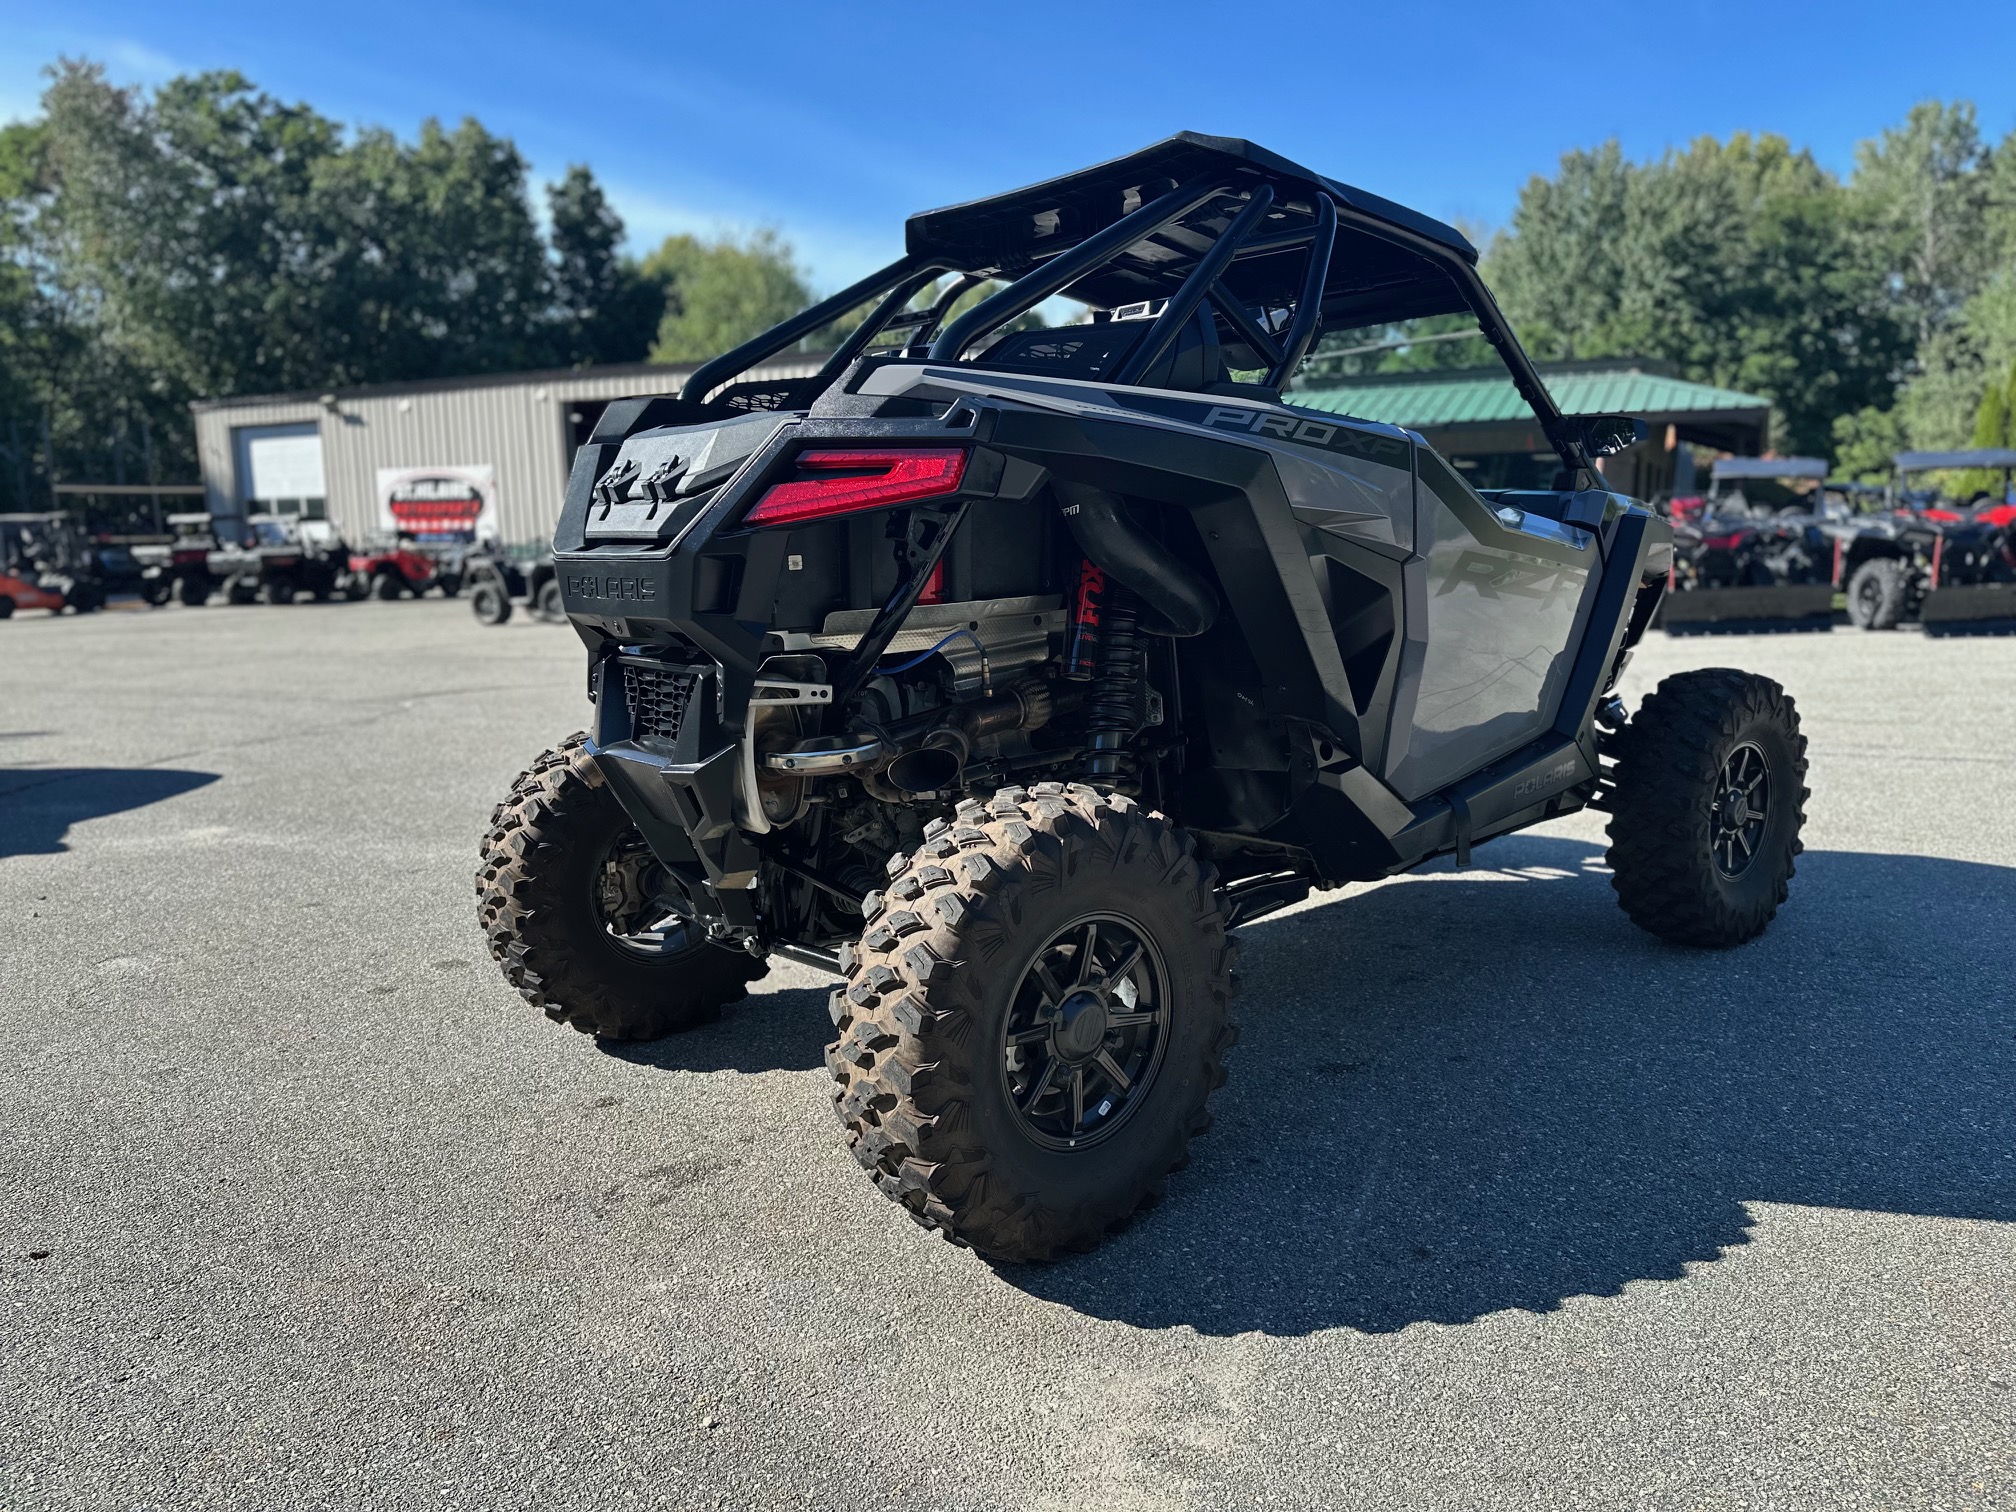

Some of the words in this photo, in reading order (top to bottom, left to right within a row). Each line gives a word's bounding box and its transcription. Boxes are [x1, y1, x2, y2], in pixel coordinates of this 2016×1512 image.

[1202, 406, 1337, 445] PRO
[1334, 430, 1405, 456] XP
[567, 575, 655, 601] POLARIS
[1075, 559, 1105, 627] FOX
[1434, 550, 1588, 613] RZR
[1513, 759, 1576, 800] POLARIS
